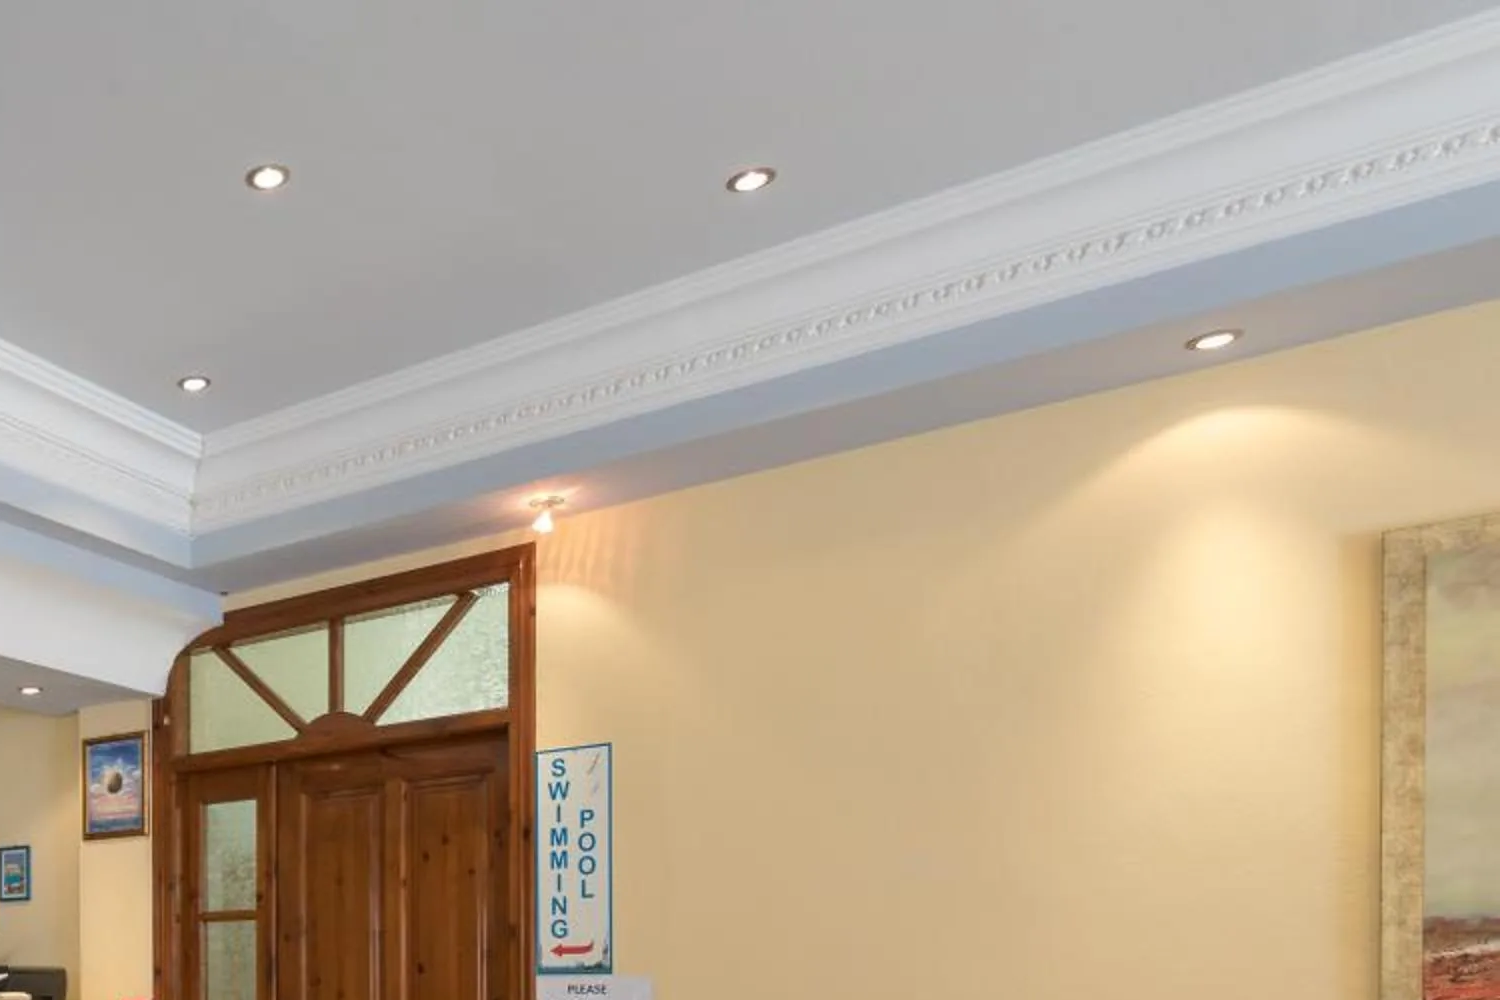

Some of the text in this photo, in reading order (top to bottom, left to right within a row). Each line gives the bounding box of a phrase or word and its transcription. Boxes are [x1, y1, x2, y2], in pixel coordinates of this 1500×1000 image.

[548, 758, 570, 939] SWIMMING
[577, 809, 596, 899] POOL
[567, 984, 607, 995] PLEASE
